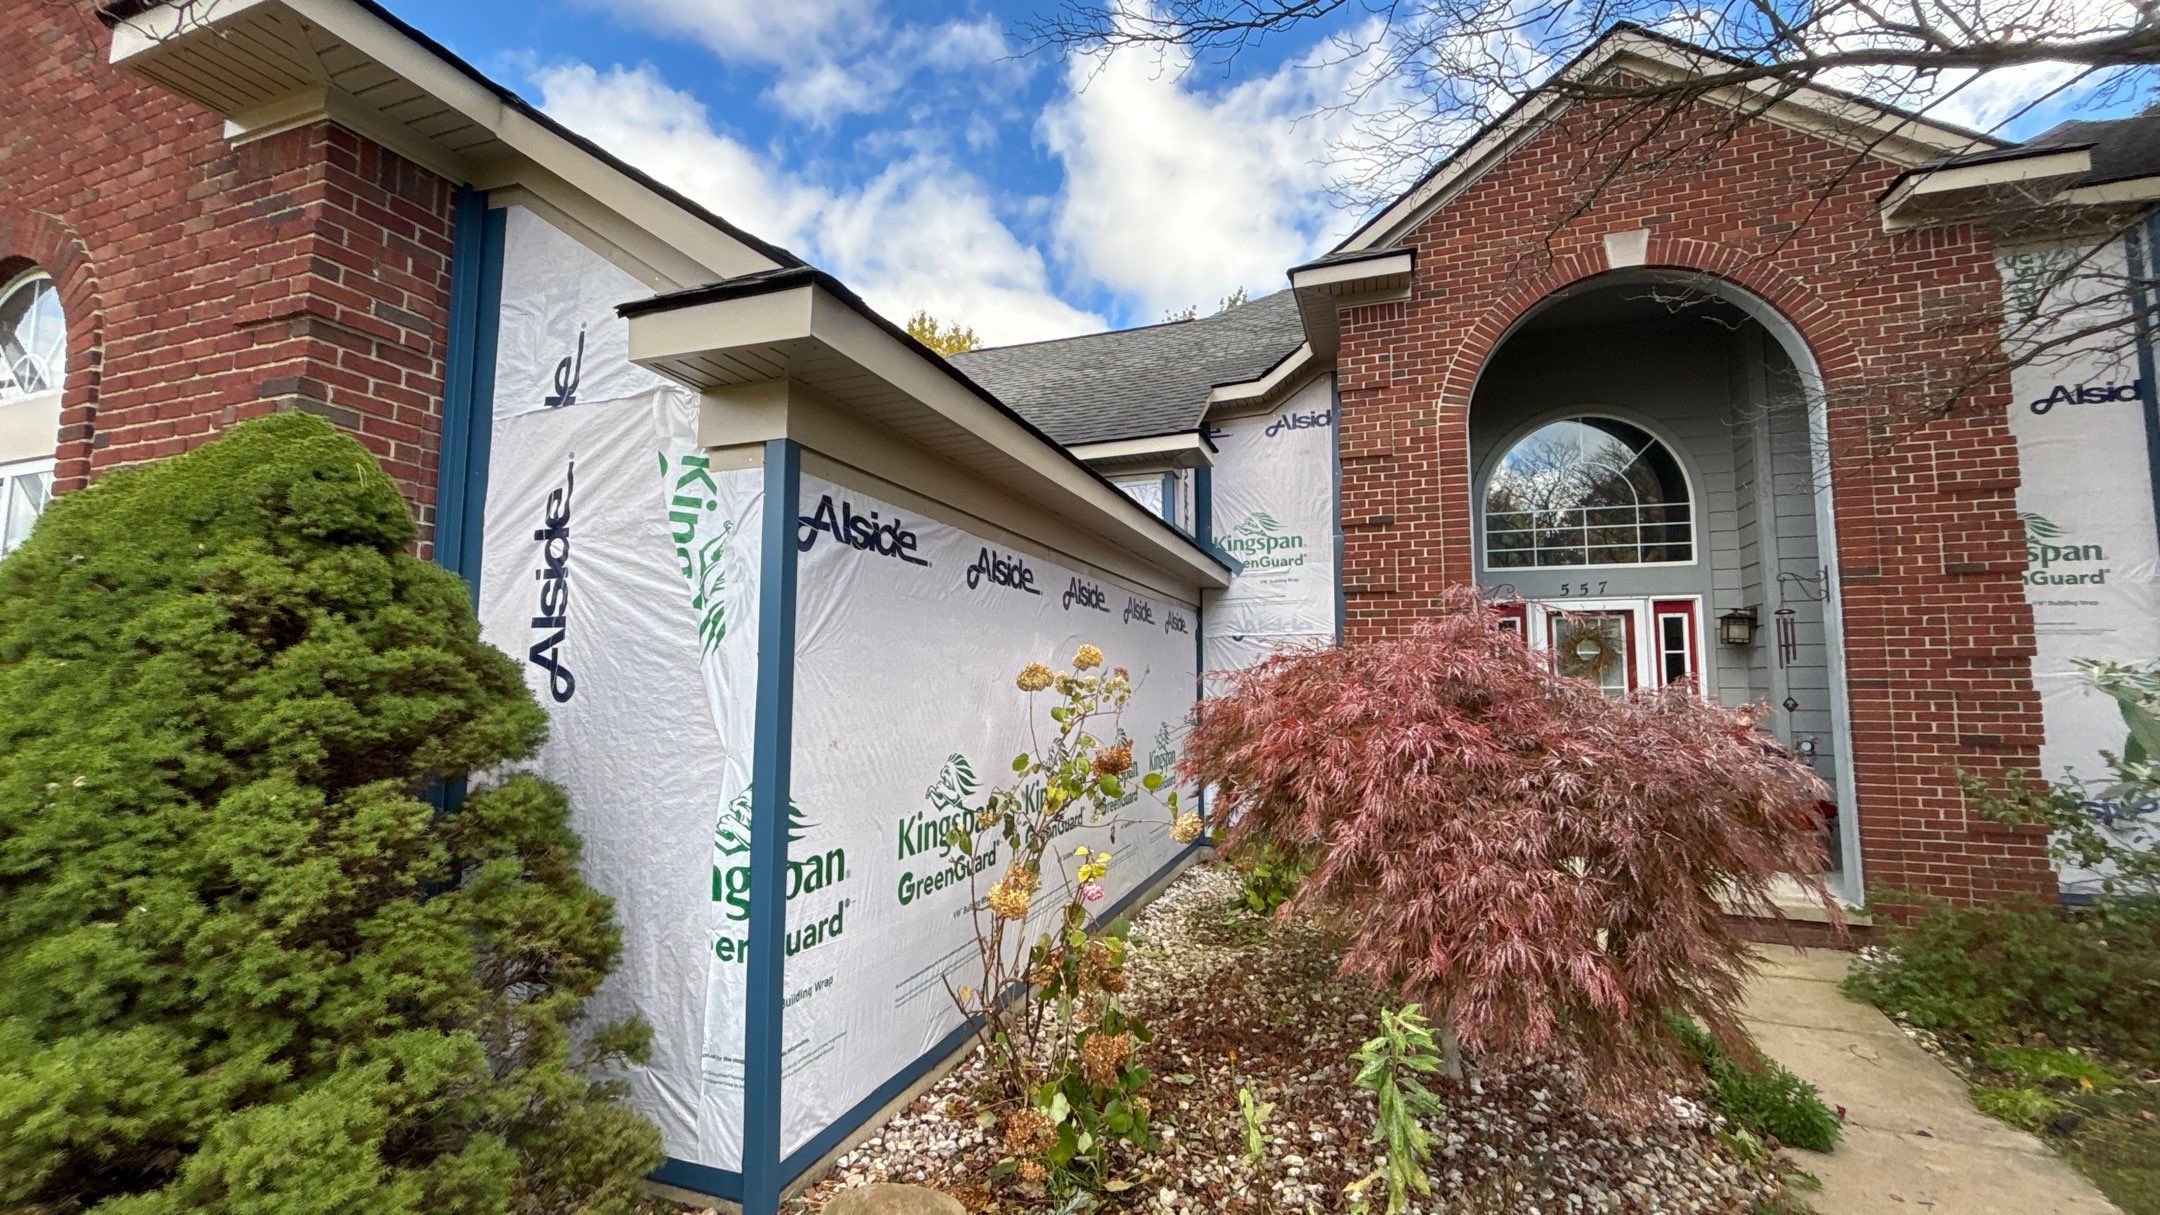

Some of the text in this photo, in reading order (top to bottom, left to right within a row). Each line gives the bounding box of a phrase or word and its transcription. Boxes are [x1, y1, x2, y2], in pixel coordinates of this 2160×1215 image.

[2030, 379, 2141, 415] Alsid
[1265, 409, 1332, 438] Alsid
[797, 494, 928, 567] Alside
[966, 546, 1041, 595] Alside
[1243, 553, 1304, 568] enGuard
[2027, 544, 2103, 569] span
[529, 461, 575, 703] Alside
[2022, 568, 2105, 586] nGuard
[1063, 576, 1111, 613] Alside
[1123, 596, 1155, 625] Alside
[1165, 610, 1189, 635] Alside
[898, 840, 996, 906] GreenGuard
[814, 975, 834, 994] Wrap
